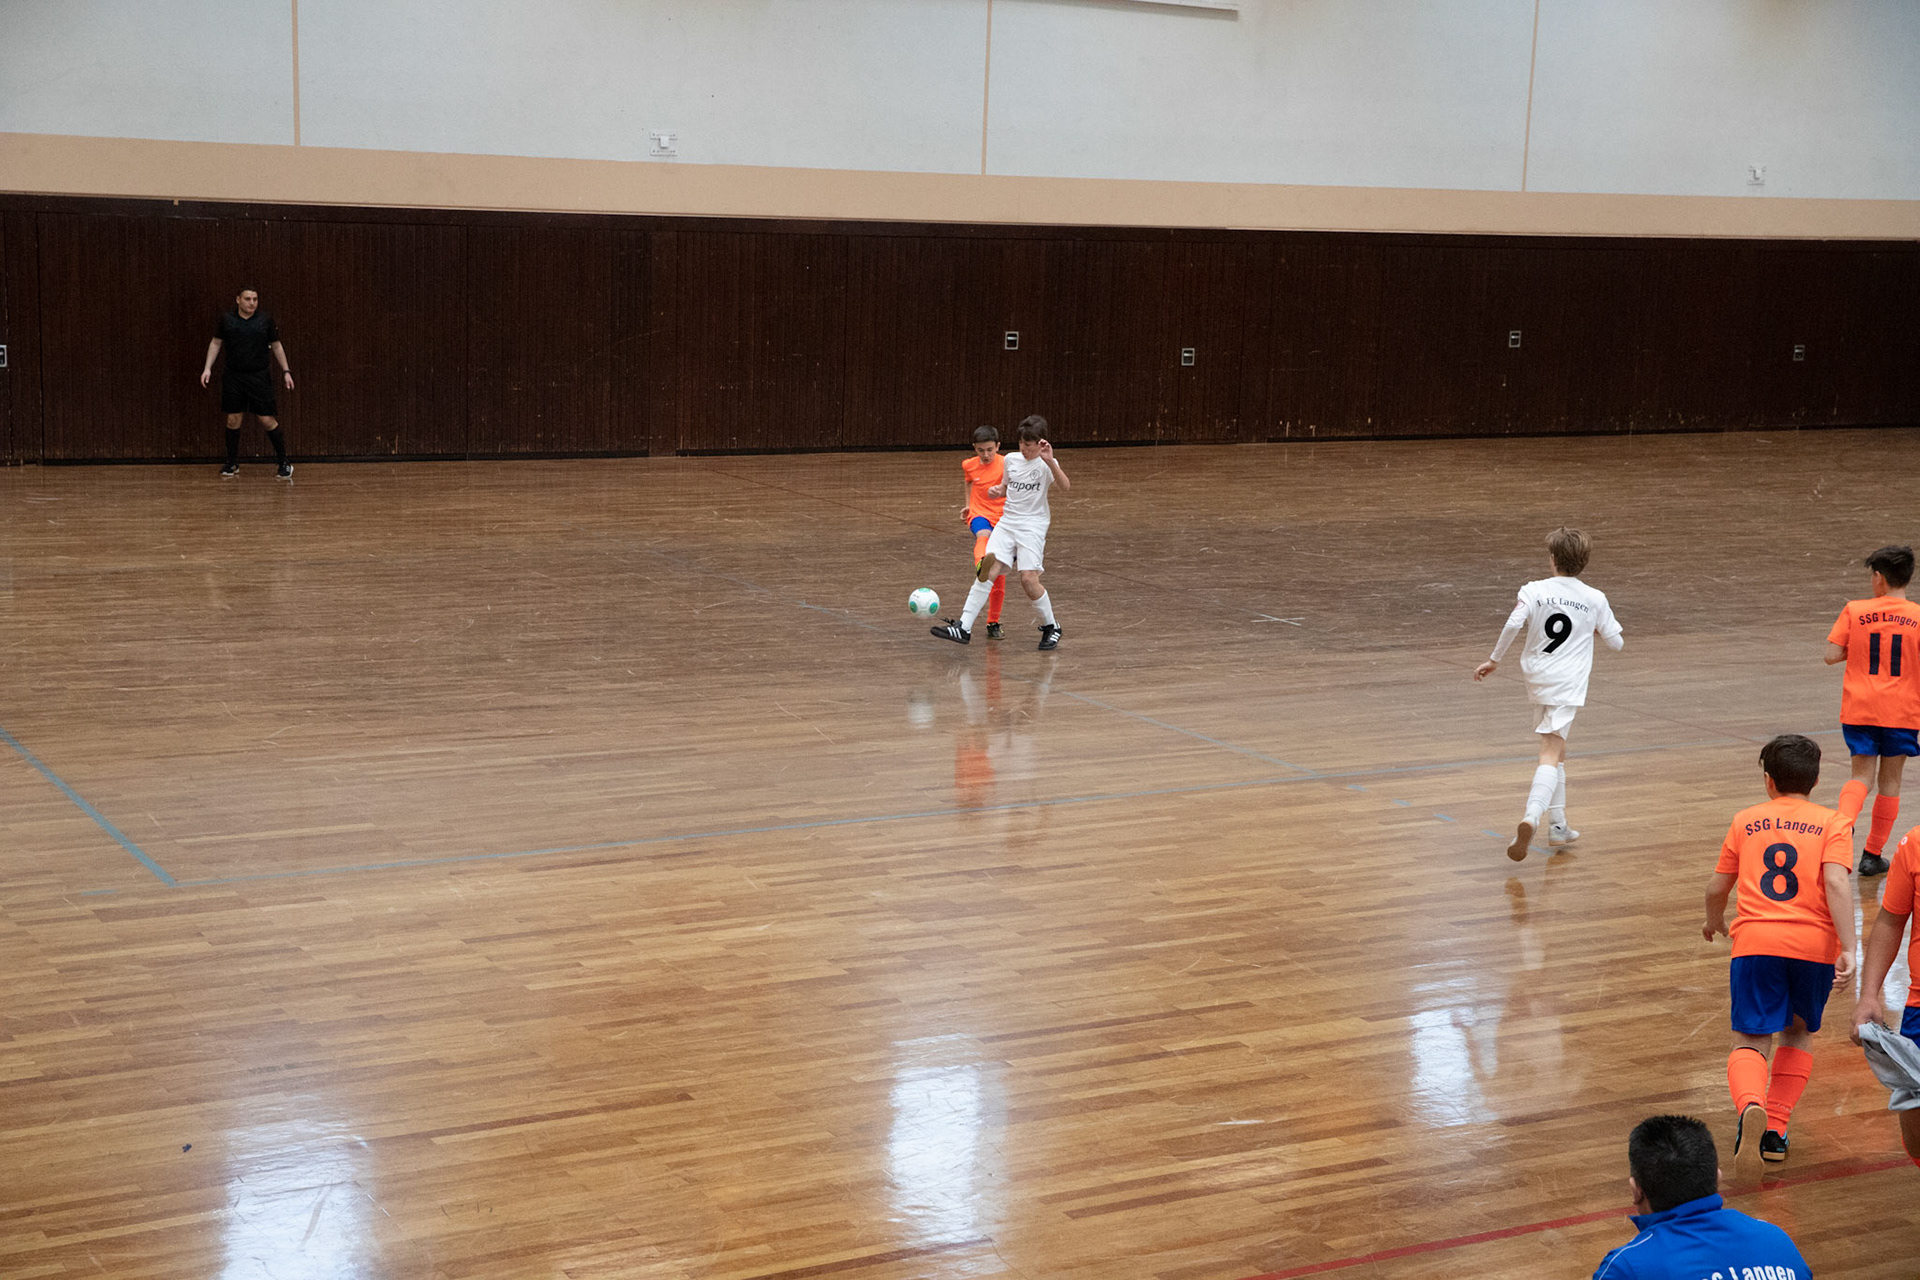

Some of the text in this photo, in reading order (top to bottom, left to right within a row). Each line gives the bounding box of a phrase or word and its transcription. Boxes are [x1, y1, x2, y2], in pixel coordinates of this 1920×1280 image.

[1008, 478, 1041, 492] raport
[1559, 597, 1589, 613] Langen
[1859, 612, 1918, 628] SSG Langen
[1542, 613, 1572, 654] 9
[1869, 633, 1903, 677] 11
[1745, 818, 1823, 836] SSG Langen
[1760, 842, 1799, 902] 8
